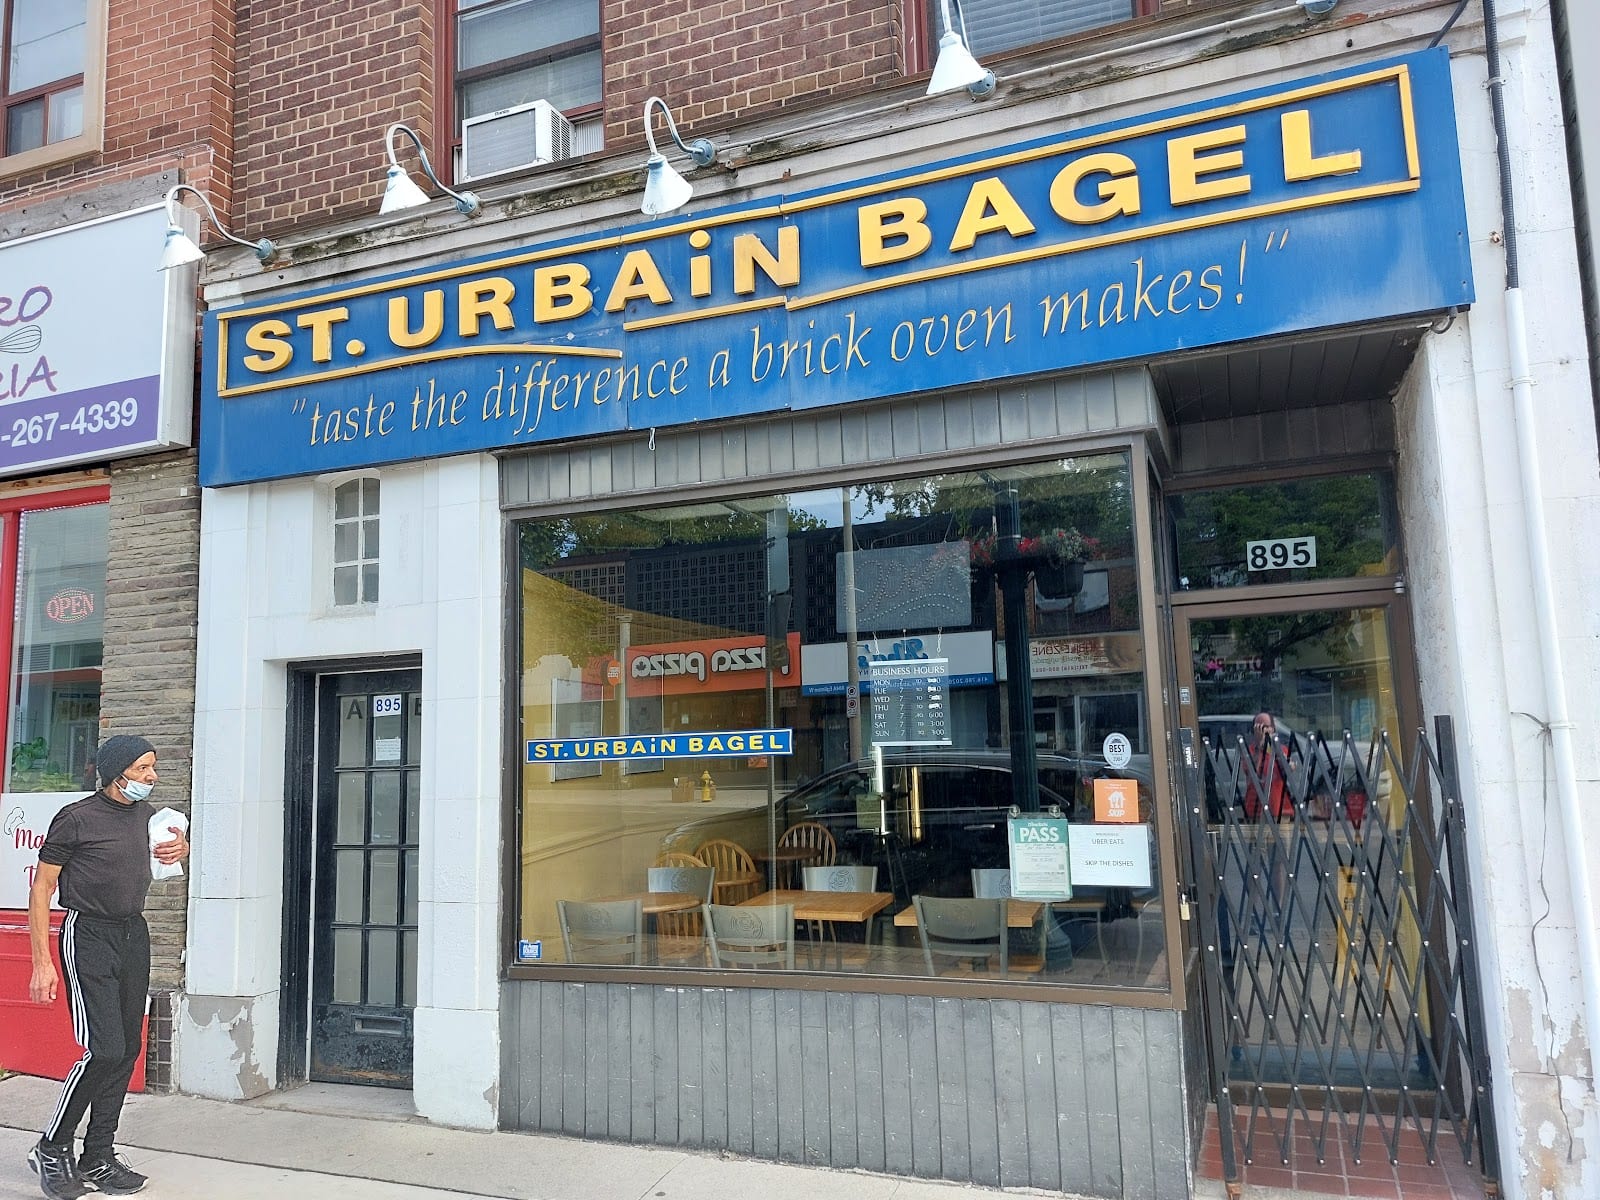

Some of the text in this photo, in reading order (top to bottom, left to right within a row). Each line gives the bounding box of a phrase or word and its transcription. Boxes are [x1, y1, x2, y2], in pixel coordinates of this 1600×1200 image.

[243, 306, 367, 374] ST.
[857, 109, 1362, 268] BAGEL
[410, 377, 468, 431] the
[482, 356, 689, 436] difference
[708, 348, 732, 387] a
[751, 310, 872, 383] brick
[890, 299, 1015, 363] oven
[1250, 541, 1311, 569] 895
[46, 593, 95, 620] OPEN
[872, 667, 911, 676] BUSINESS
[913, 665, 945, 674] HOURS
[346, 698, 363, 720] A
[376, 698, 401, 712] 895
[534, 743, 569, 758] ST.
[688, 735, 784, 752] BAGEL
[1109, 744, 1125, 753] BEST
[1020, 826, 1060, 843] PASS
